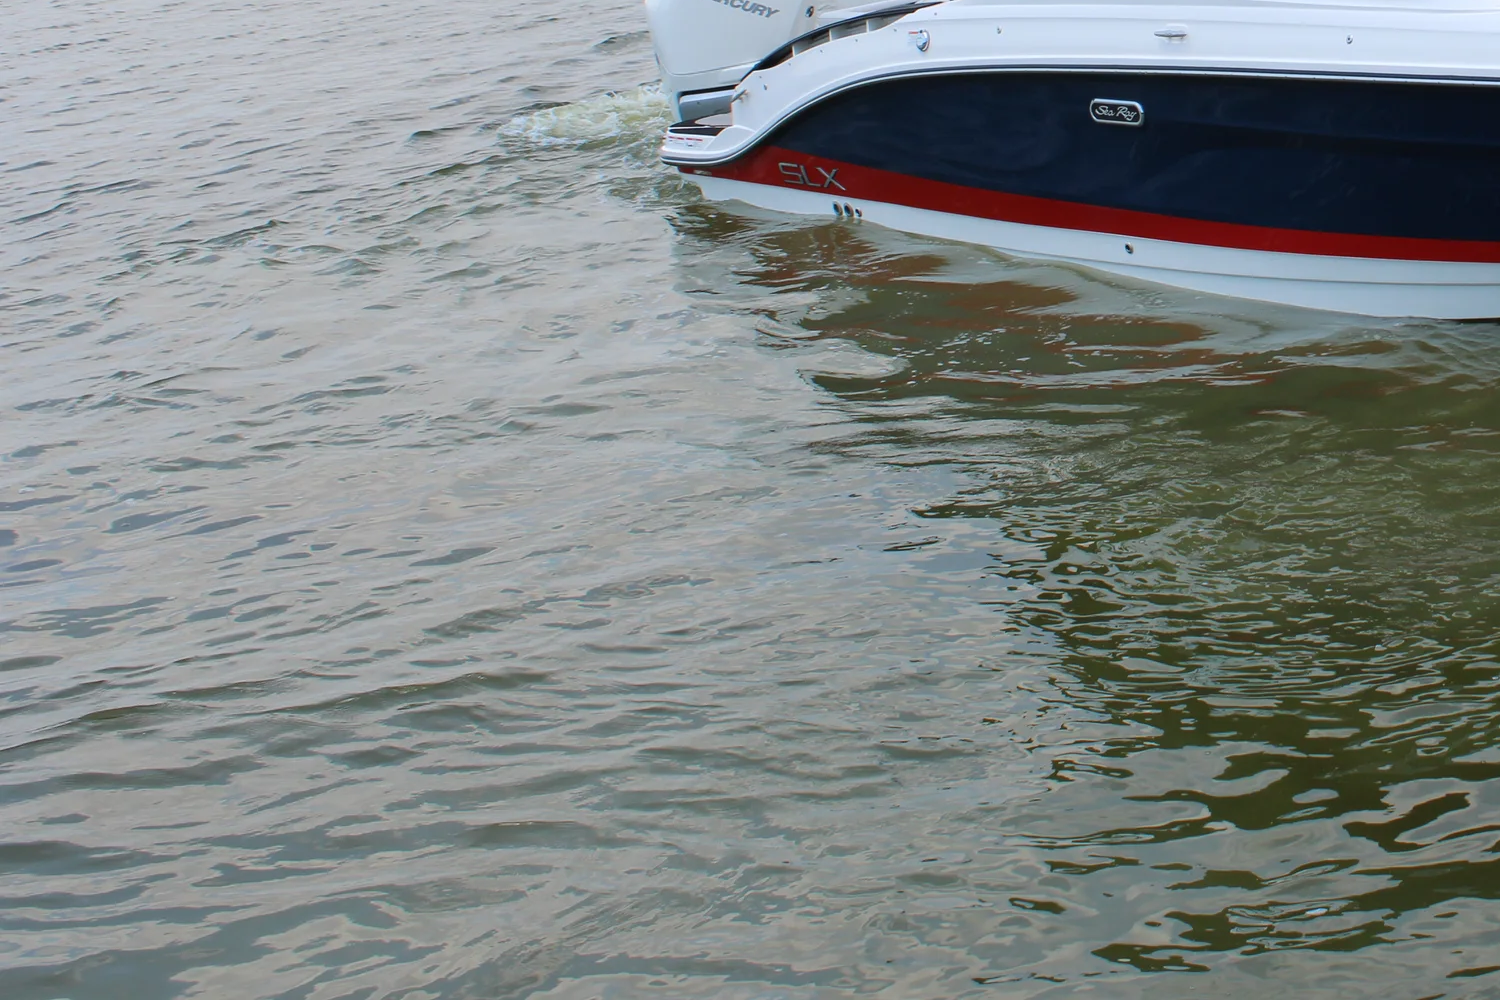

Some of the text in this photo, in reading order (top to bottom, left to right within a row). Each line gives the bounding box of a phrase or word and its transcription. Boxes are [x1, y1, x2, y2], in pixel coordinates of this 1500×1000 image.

[1095, 105, 1138, 121] Sea Ray
[778, 162, 847, 191] SLX
